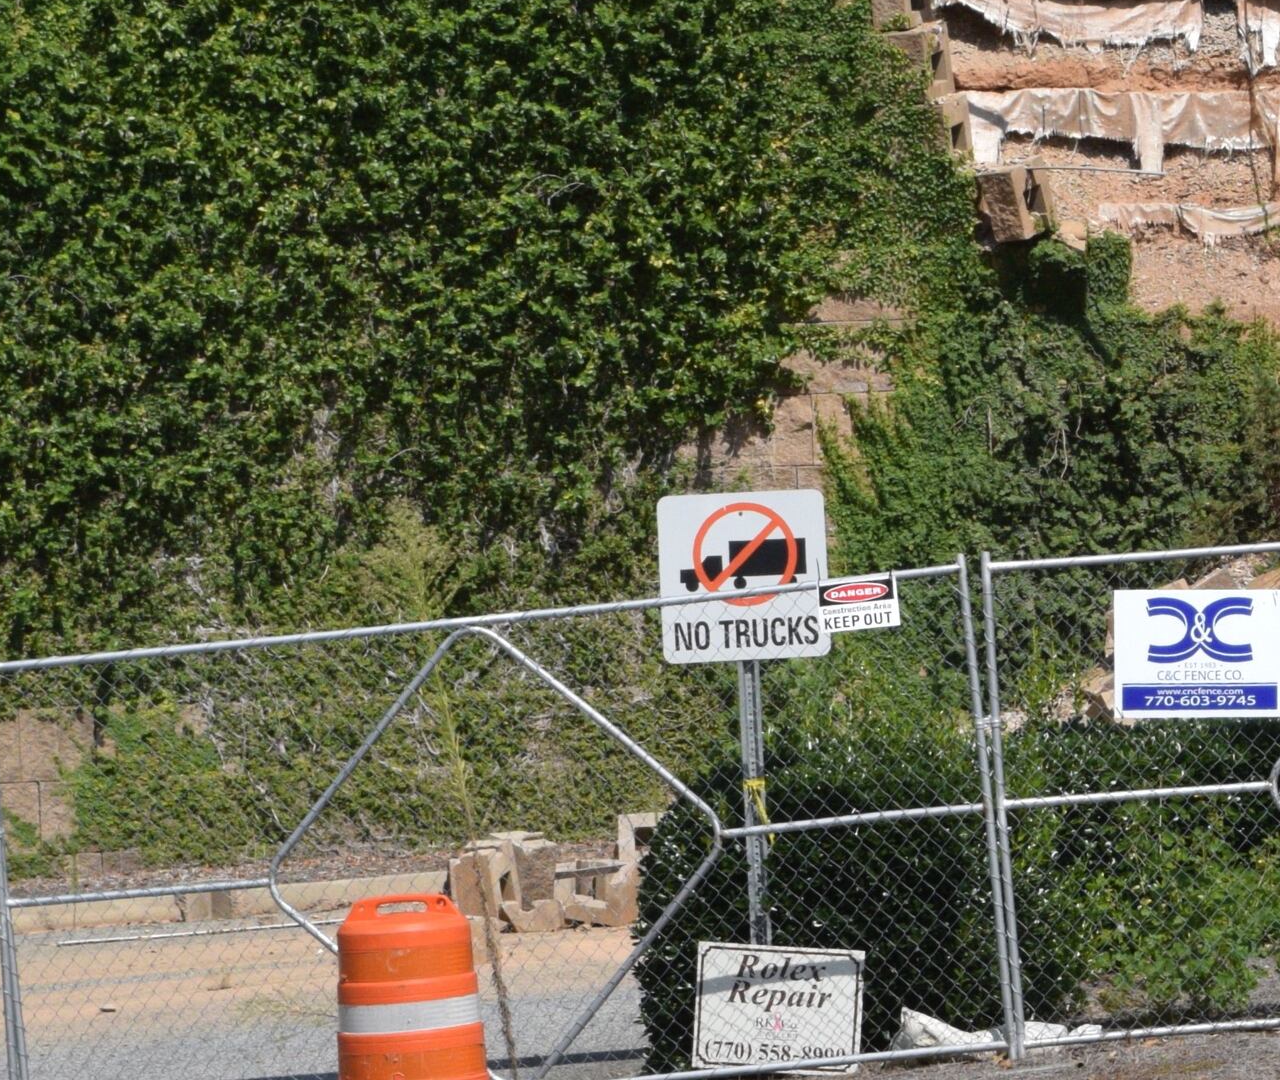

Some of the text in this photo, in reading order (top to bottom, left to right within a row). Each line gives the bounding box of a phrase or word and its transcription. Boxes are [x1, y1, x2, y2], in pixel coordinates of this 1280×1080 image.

[830, 587, 882, 599] DANGER
[822, 602, 892, 616] Construction Area
[824, 611, 892, 630] KEEP OUT
[674, 615, 820, 651] NO TRUCKS
[1157, 669, 1245, 681] C&C FENCE CO.
[1157, 687, 1244, 696] www.cncfence.com
[1144, 695, 1257, 706] 770-603-9745
[736, 954, 826, 982] Rolex
[726, 980, 832, 1013] Repair
[705, 1040, 752, 1060] (770)
